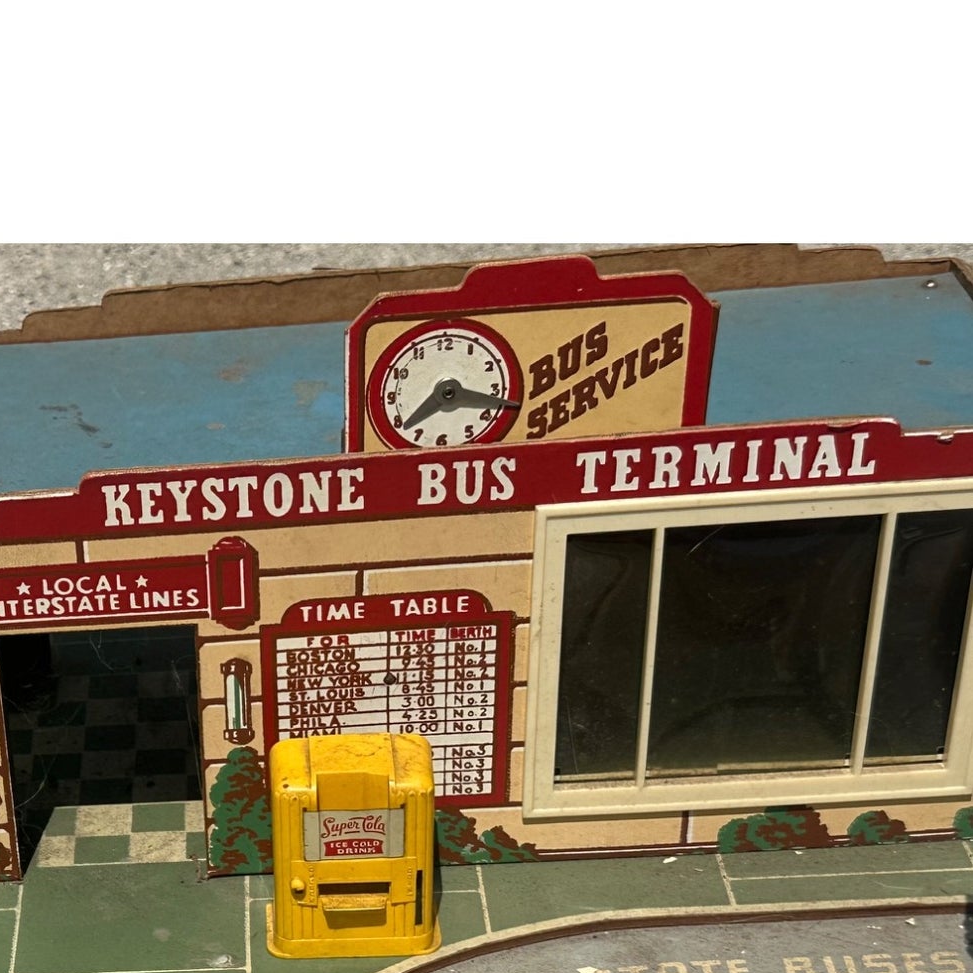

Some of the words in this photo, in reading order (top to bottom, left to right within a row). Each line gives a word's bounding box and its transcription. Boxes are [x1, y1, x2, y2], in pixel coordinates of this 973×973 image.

[437, 338, 453, 351] 12
[484, 361, 494, 372] 2
[529, 321, 607, 400] BUS
[393, 367, 409, 380] 10
[526, 323, 684, 439] SERVICE
[490, 383, 500, 397] 3
[387, 391, 396, 405] 9
[393, 415, 403, 428] 8
[479, 408, 492, 422] 4
[414, 428, 423, 442] 7
[464, 425, 474, 439] 5
[435, 434, 447, 446] 6
[101, 468, 365, 526] KEYSTONE
[417, 457, 516, 505] BUS
[576, 432, 876, 494] TERMINAL
[42, 574, 127, 596] LOCAL
[129, 588, 201, 609] LINES
[300, 602, 366, 622] TIME
[390, 596, 469, 617] TABLE
[395, 629, 436, 643] TIME
[449, 626, 492, 639] BERTH
[307, 633, 349, 648] FOR
[287, 647, 355, 664] BOSTON
[287, 661, 360, 677] CHICAGO
[287, 676, 323, 691] NEW
[328, 673, 372, 688] YORK
[289, 691, 310, 702] ST.
[317, 687, 366, 701] LOUIS
[290, 700, 358, 716] DENVER
[320, 816, 361, 838] Super
[348, 815, 386, 836] Cola
